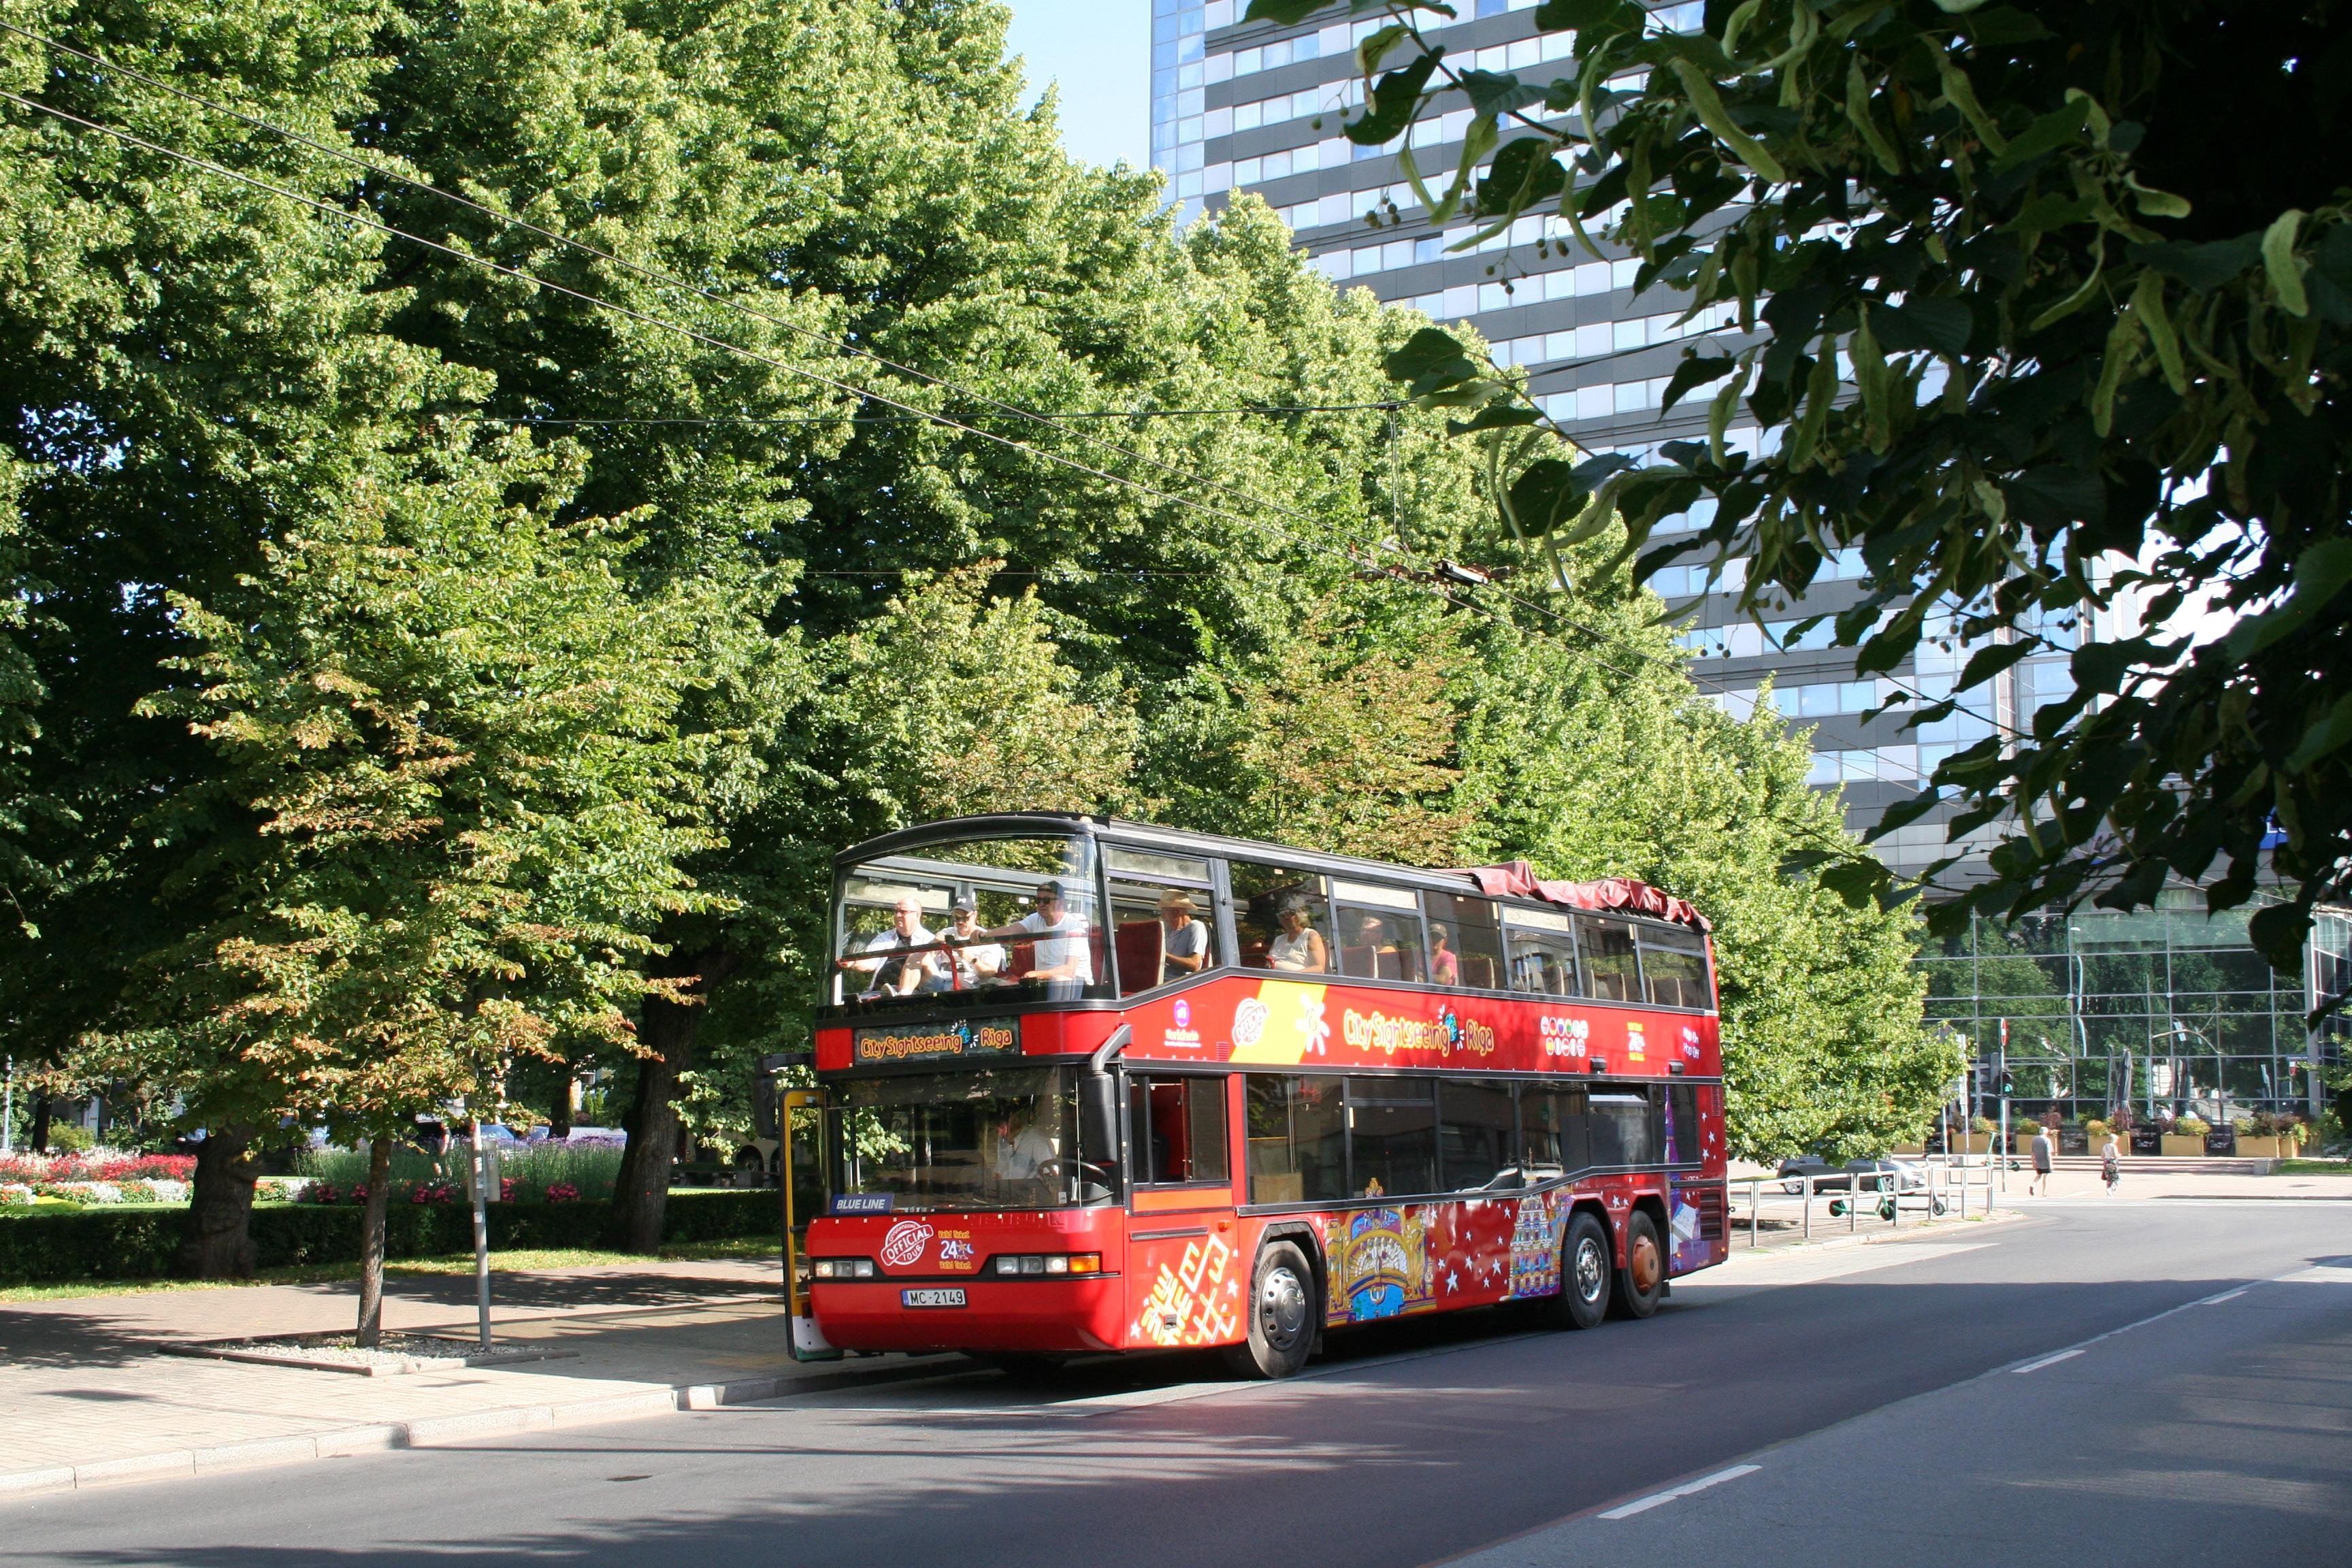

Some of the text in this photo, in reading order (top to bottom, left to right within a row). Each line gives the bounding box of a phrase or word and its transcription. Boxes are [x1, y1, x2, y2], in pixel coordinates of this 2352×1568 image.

[981, 1027, 1013, 1049] Riga
[1466, 1019, 1494, 1056] Riga
[836, 1198, 885, 1209] BLUE LINE
[886, 1227, 930, 1260] OFFICIAL
[903, 1246, 923, 1261] TOUR
[941, 1240, 958, 1260] 24
